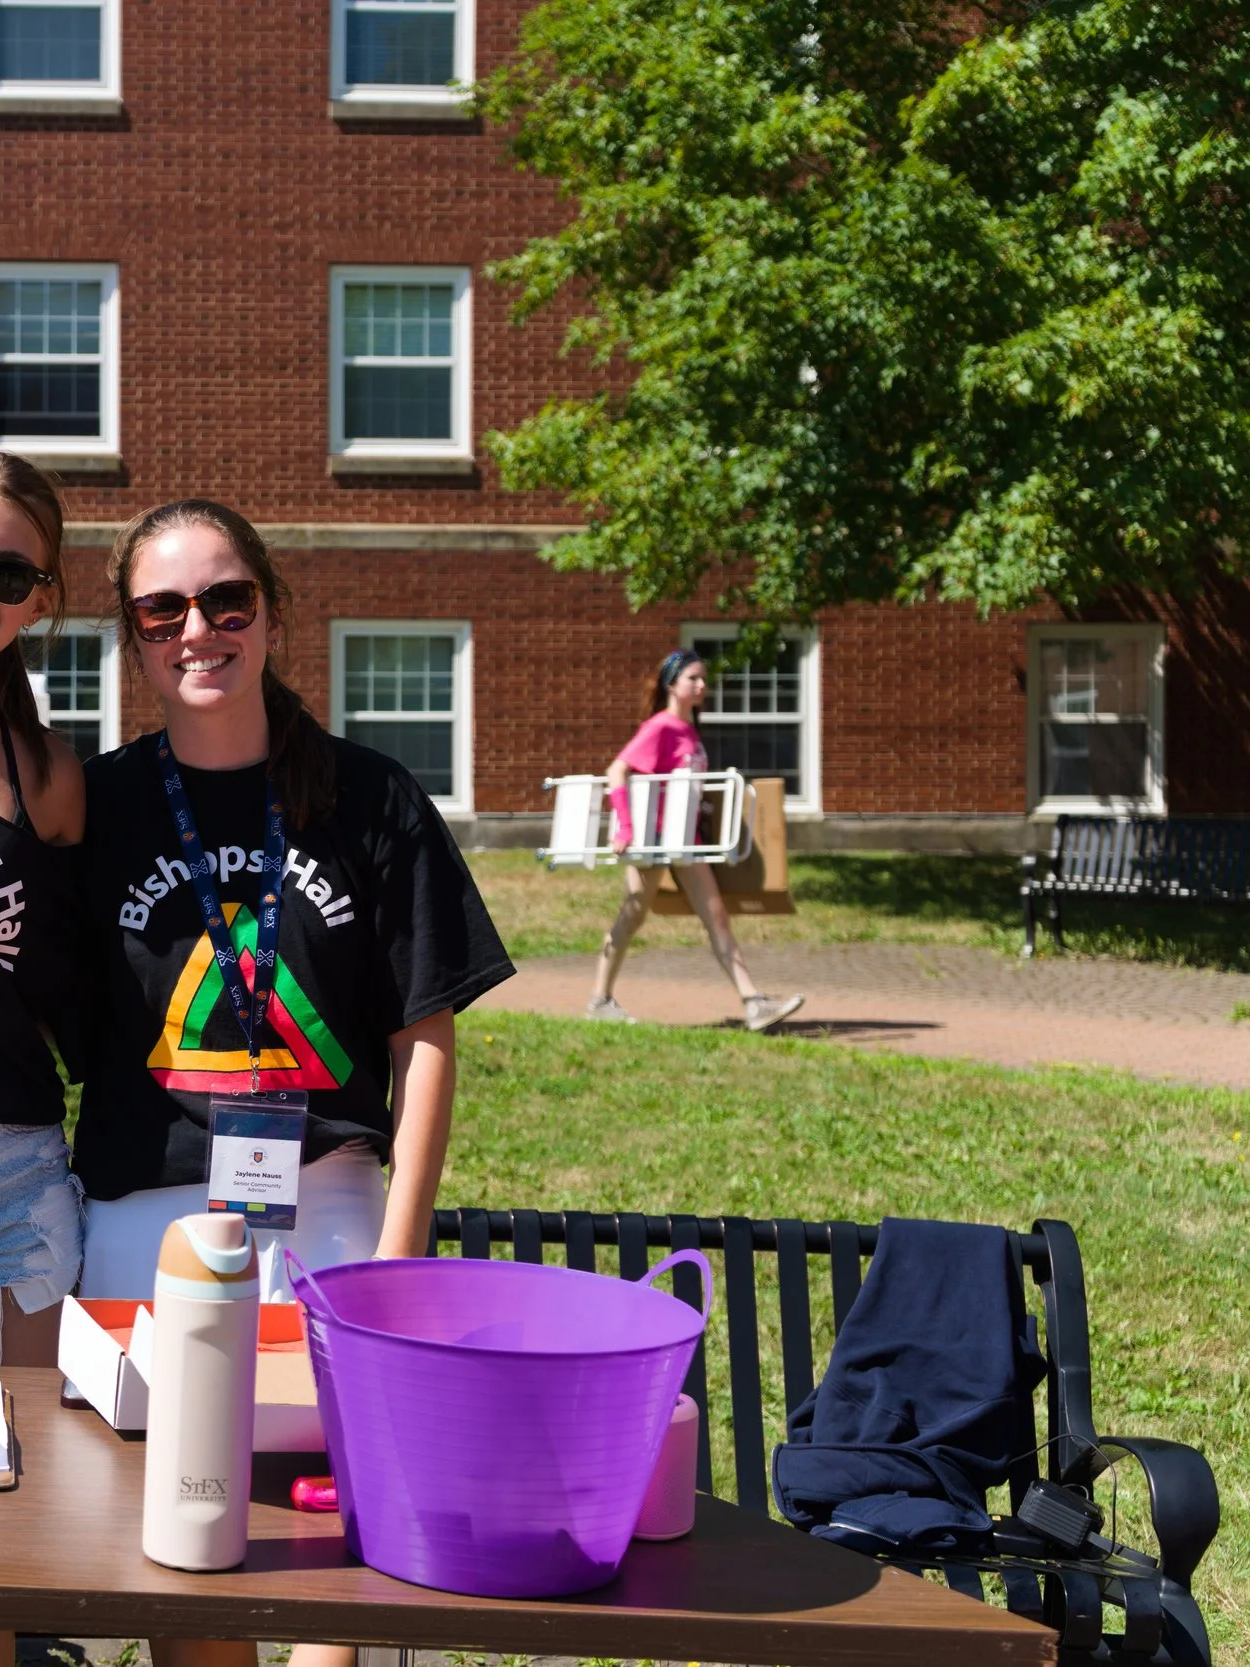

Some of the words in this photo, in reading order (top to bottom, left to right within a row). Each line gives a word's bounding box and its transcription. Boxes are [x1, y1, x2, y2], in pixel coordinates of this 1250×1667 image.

[282, 848, 355, 928] Hall
[235, 1171, 261, 1179] Jaylene
[250, 1181, 282, 1189] Community
